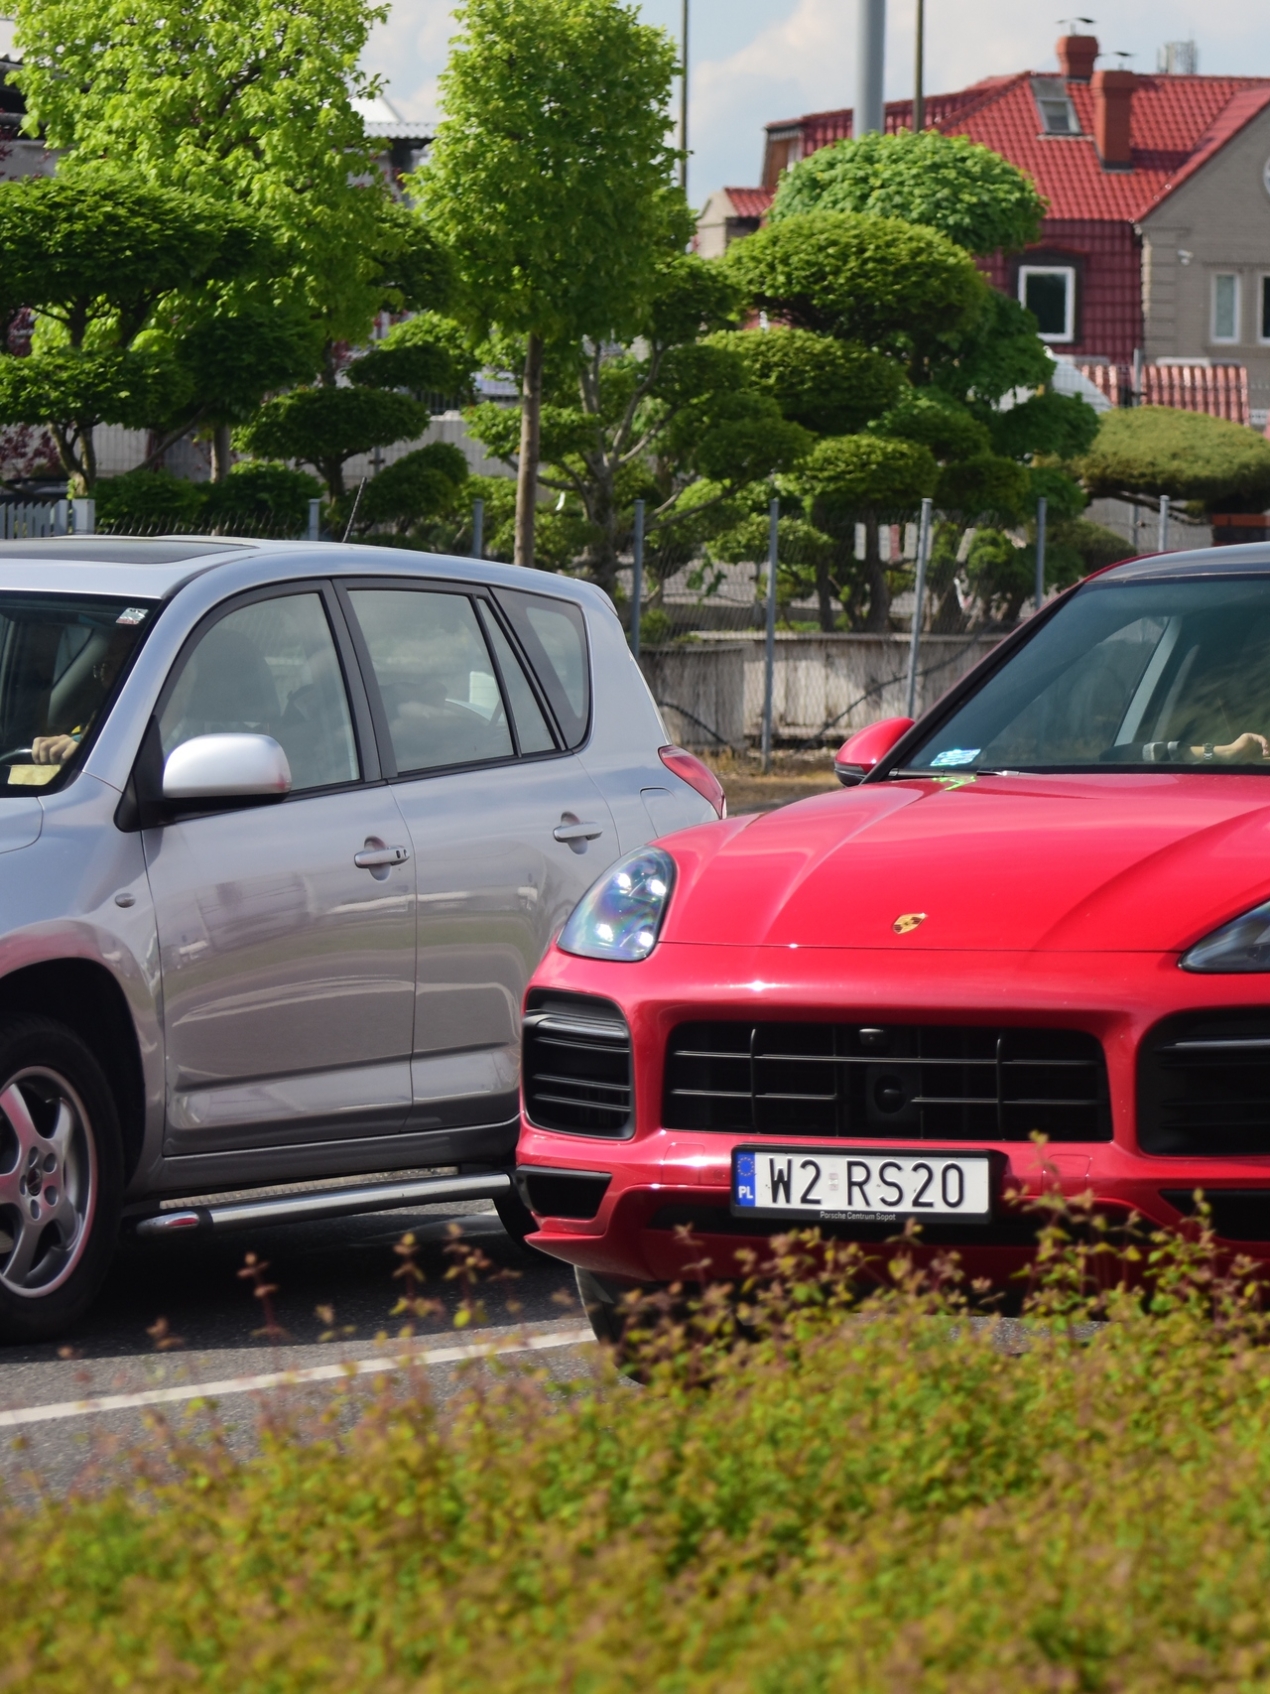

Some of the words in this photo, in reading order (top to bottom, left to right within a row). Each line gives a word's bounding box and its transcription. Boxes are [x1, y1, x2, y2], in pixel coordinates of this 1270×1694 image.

[768, 1157, 822, 1205] W2
[846, 1158, 964, 1208] RS20
[738, 1186, 754, 1199] PL
[819, 1211, 846, 1220] Porsche
[847, 1211, 875, 1220] Centrum
[875, 1212, 896, 1222] Sopot
